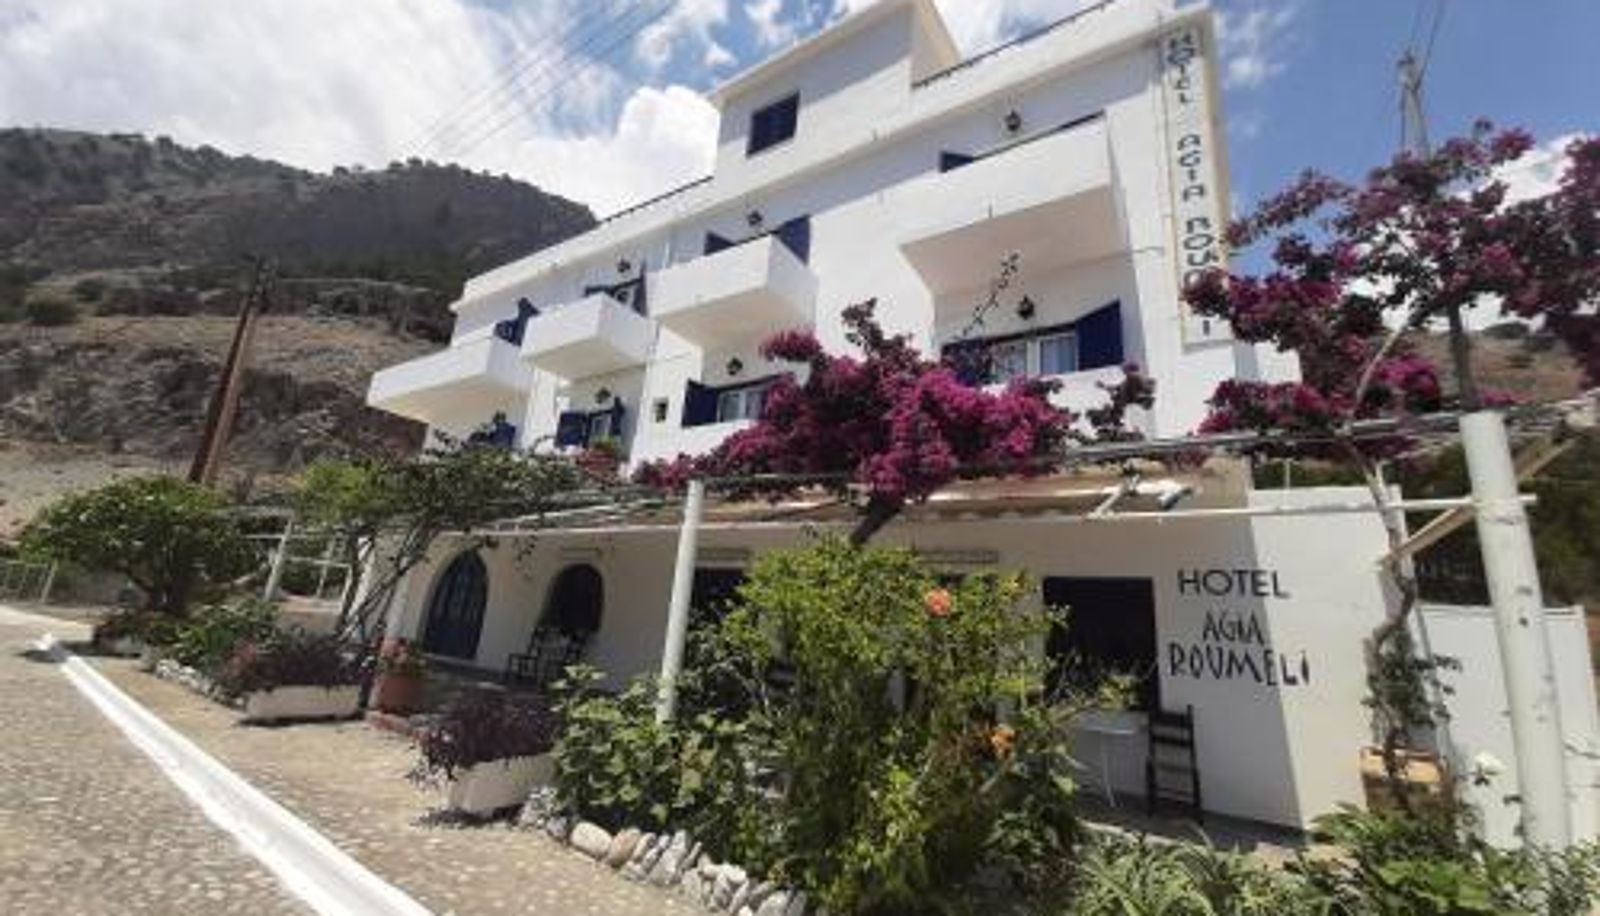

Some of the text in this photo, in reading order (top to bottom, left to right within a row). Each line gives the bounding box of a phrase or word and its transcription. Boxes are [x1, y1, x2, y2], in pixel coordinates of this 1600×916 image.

[1167, 33, 1219, 336] HOTEL AGIA ROUI
[1177, 568, 1292, 599] HOTEL
[1202, 610, 1266, 646] AGIA
